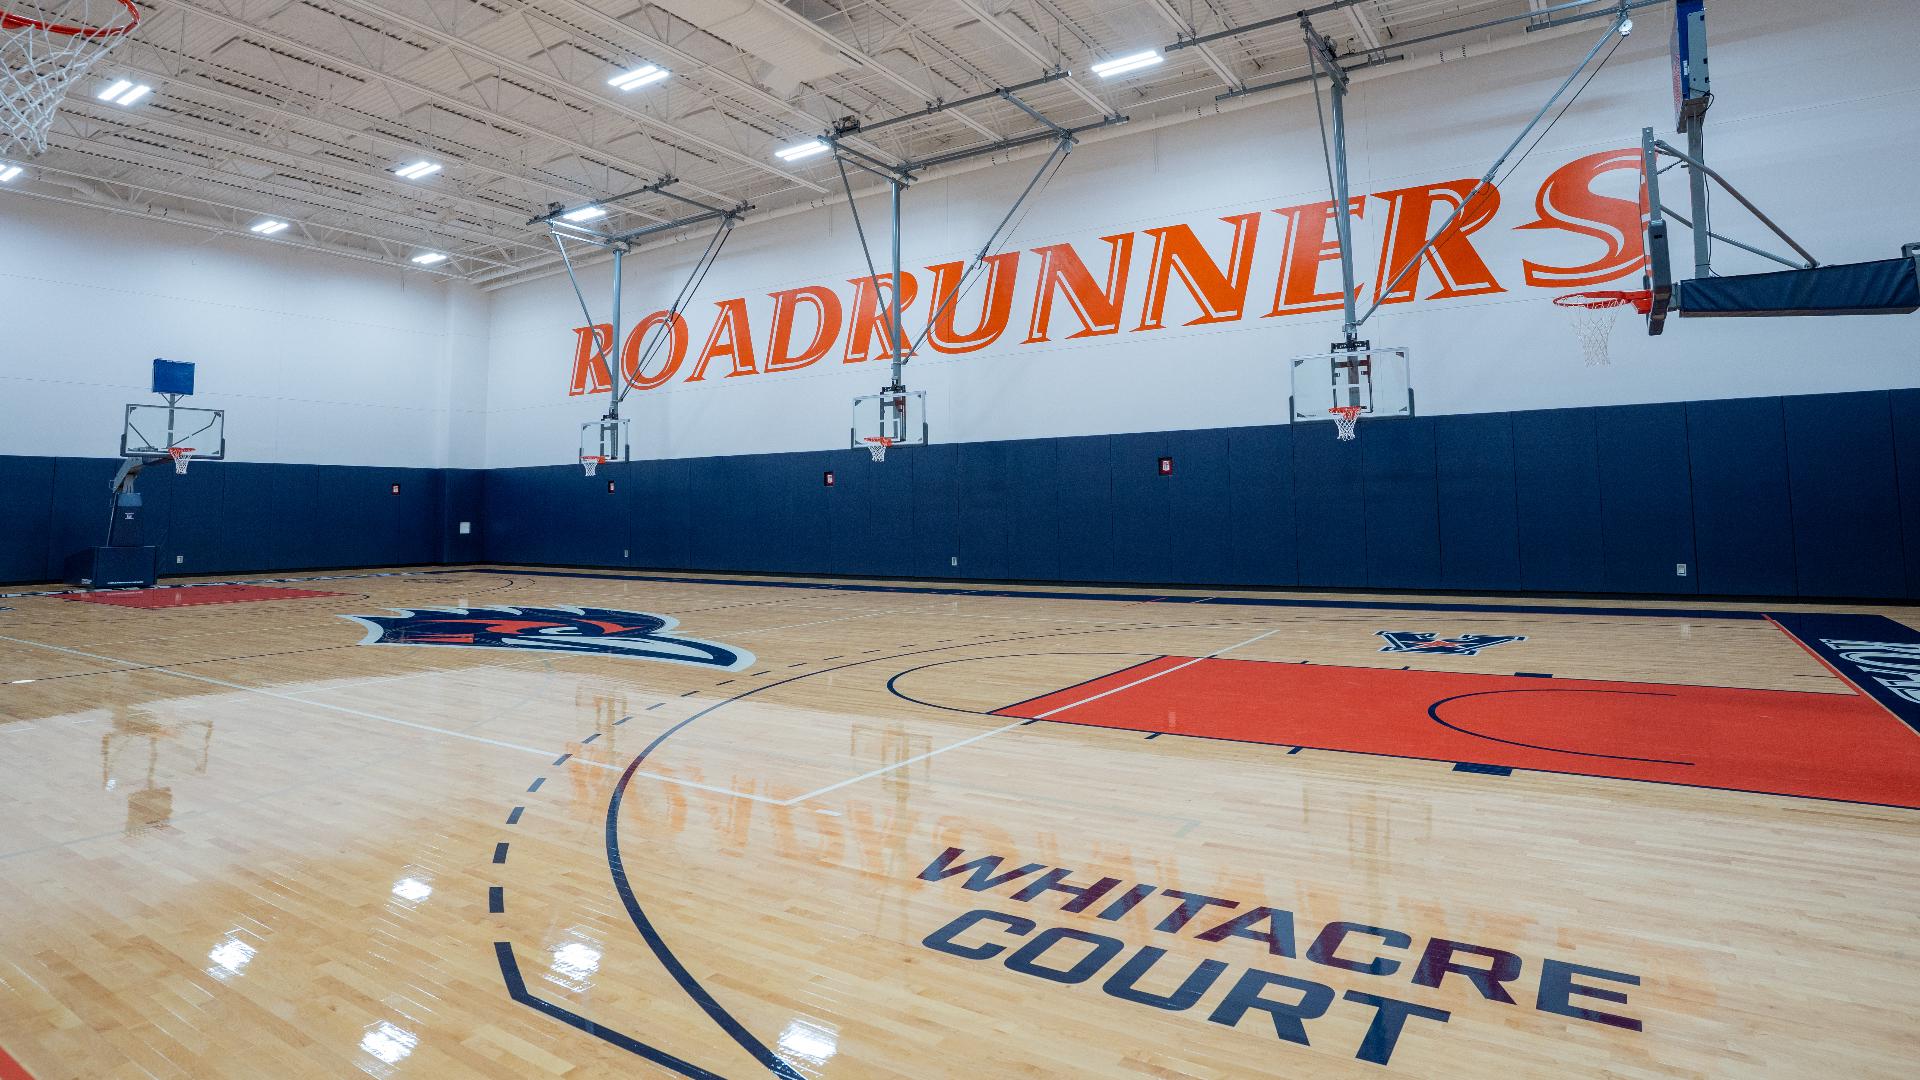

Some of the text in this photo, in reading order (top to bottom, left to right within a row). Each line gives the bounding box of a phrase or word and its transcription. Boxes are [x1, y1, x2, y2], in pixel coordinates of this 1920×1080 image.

[569, 148, 1656, 396] ROADRUNNERS
[918, 848, 1642, 1032] WHITACRE
[922, 910, 1451, 1066] COURT
